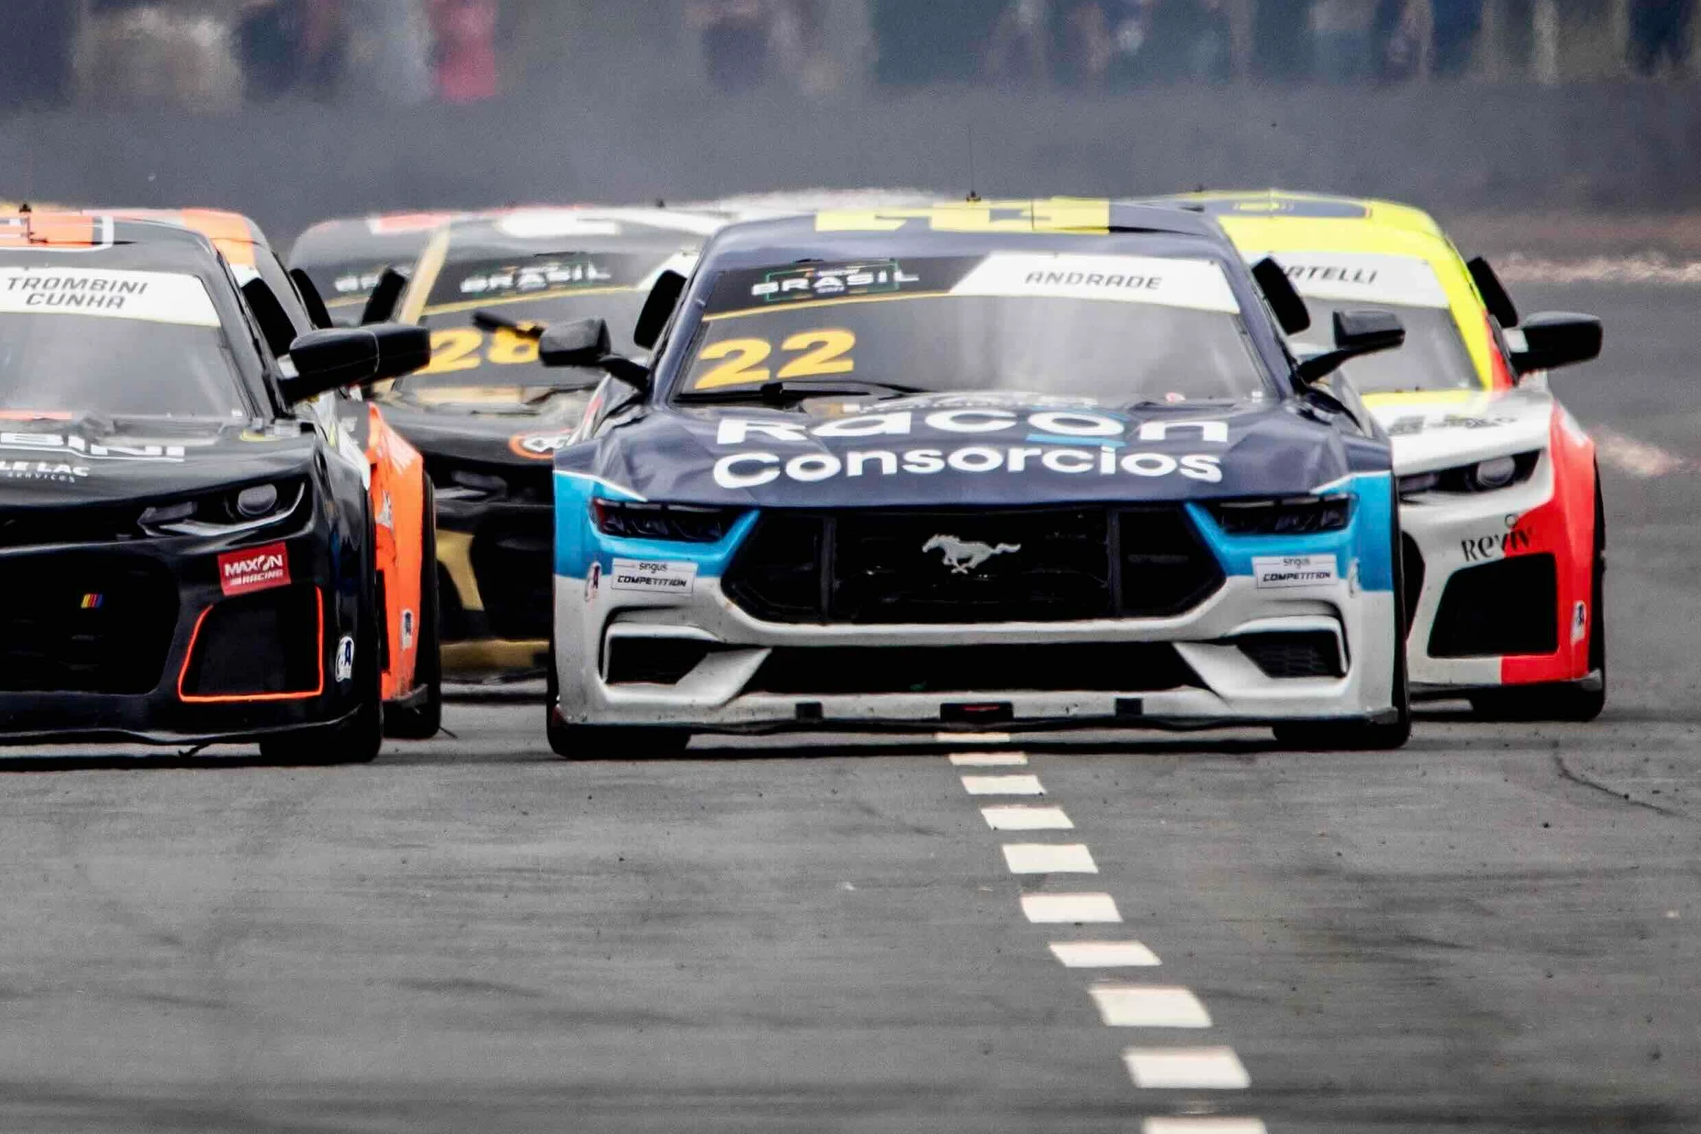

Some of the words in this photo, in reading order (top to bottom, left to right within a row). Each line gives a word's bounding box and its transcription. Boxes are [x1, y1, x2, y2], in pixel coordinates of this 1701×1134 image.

[7, 277, 148, 295] TROMBINI
[752, 270, 919, 295] BRASIL
[1025, 271, 1163, 289] ANDRADE
[25, 292, 126, 309] CUNHA
[694, 329, 855, 389] 22
[716, 410, 1229, 444] Racon
[37, 462, 90, 477] LAC
[713, 444, 1223, 489] Consorcios
[224, 554, 283, 577] MAXON
[242, 569, 284, 585] RACING
[617, 575, 687, 587] COMPETITION
[1263, 571, 1331, 583] COMPETITION
